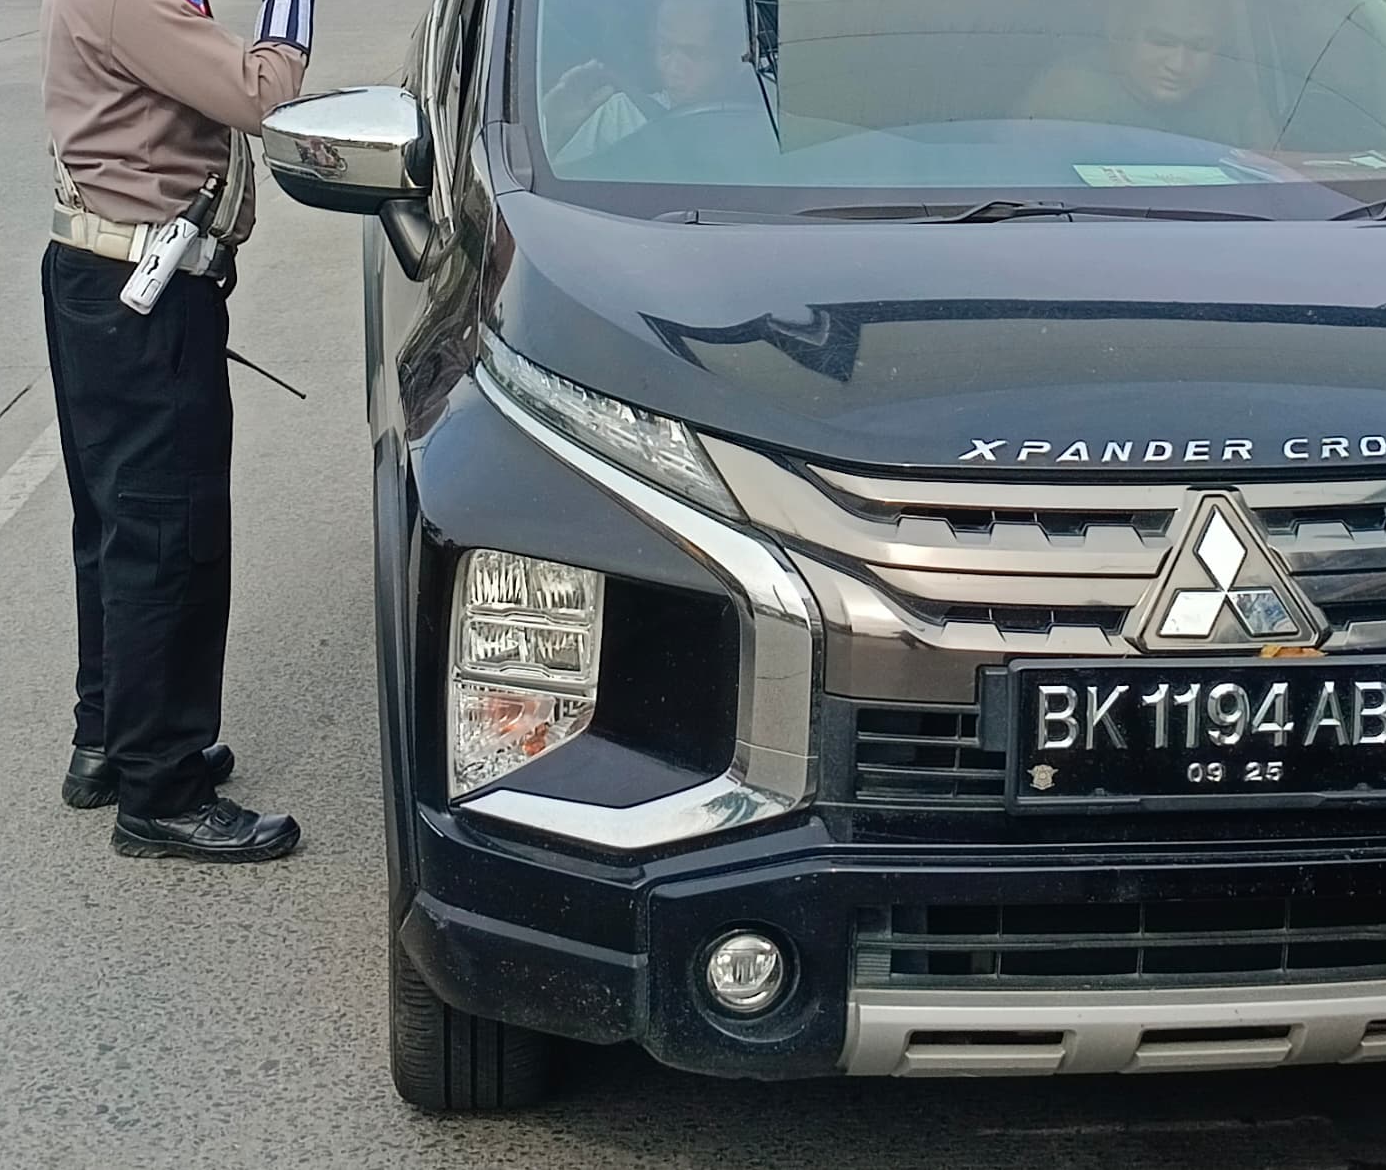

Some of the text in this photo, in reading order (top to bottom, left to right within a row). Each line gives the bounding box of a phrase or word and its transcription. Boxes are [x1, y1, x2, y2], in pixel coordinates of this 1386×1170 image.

[959, 439, 1253, 463] XPANDER
[1037, 683, 1129, 750] BK
[1141, 682, 1294, 748] 1194
[1187, 761, 1283, 783] 09 25
